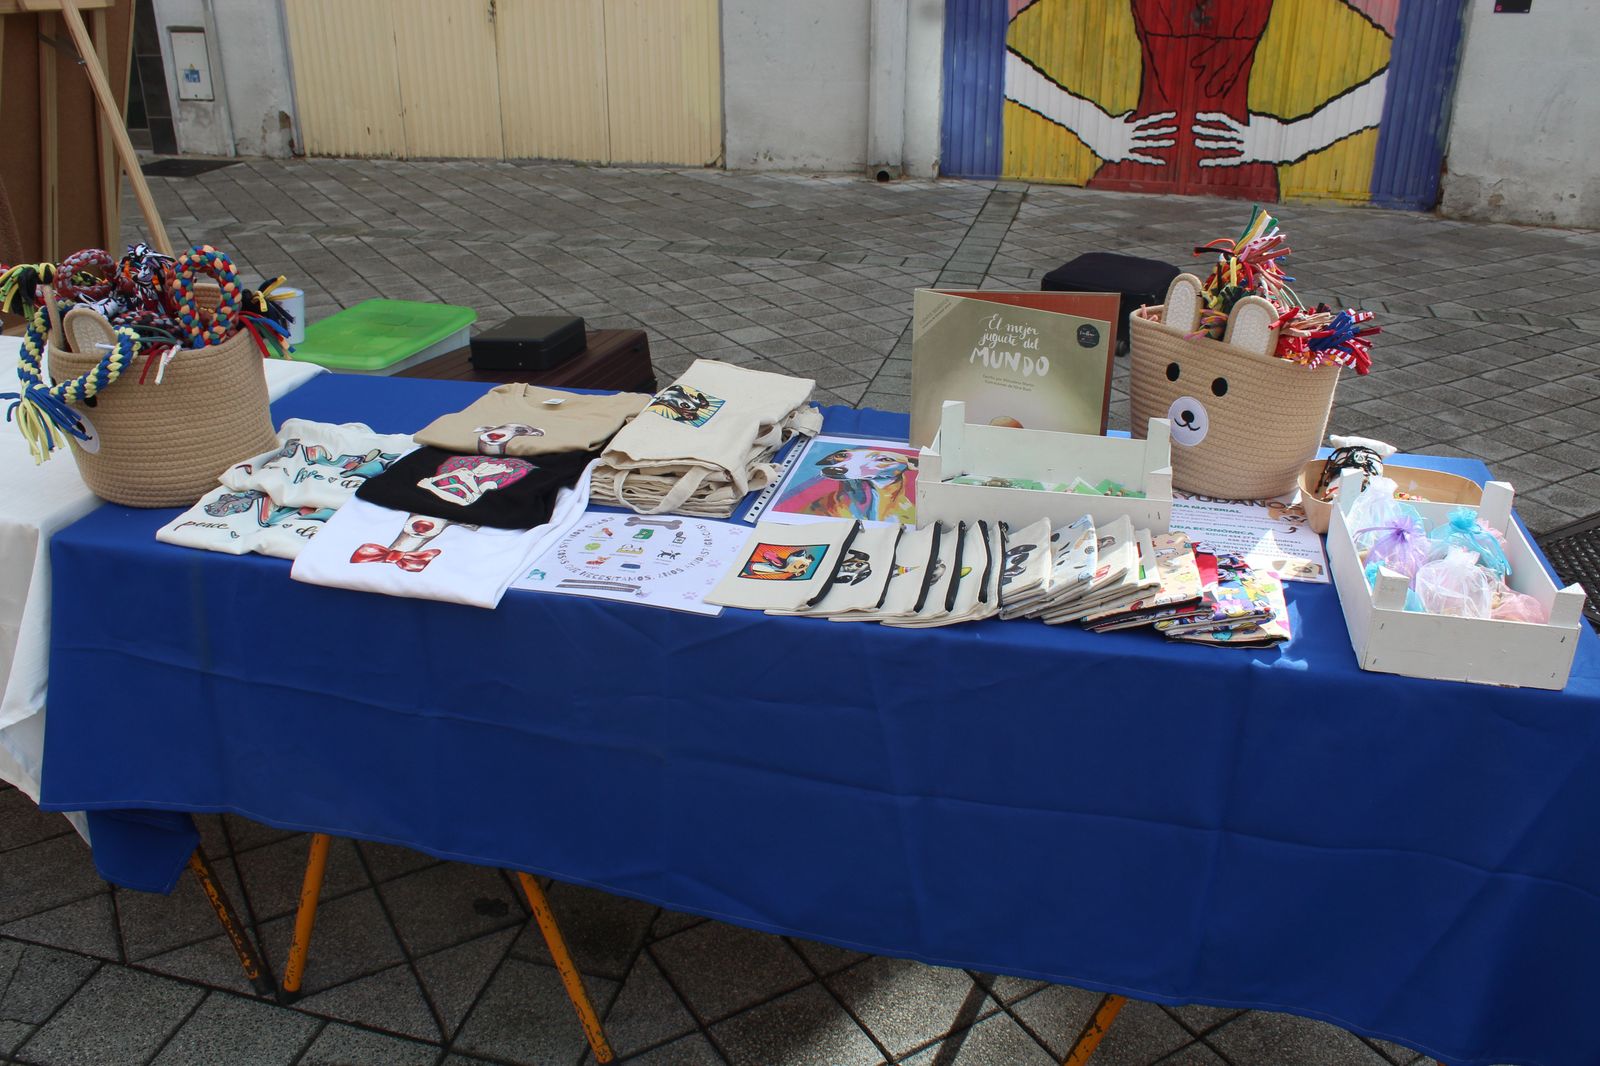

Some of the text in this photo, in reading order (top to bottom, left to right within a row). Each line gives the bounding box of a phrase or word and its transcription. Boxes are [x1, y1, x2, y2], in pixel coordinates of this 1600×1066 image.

[985, 313, 1040, 340] El mejor
[978, 328, 1040, 350] juguete del
[969, 346, 1050, 377] MUNDO
[293, 467, 325, 485] love
[1191, 505, 1242, 514] MATERIAL
[173, 520, 229, 532] peace
